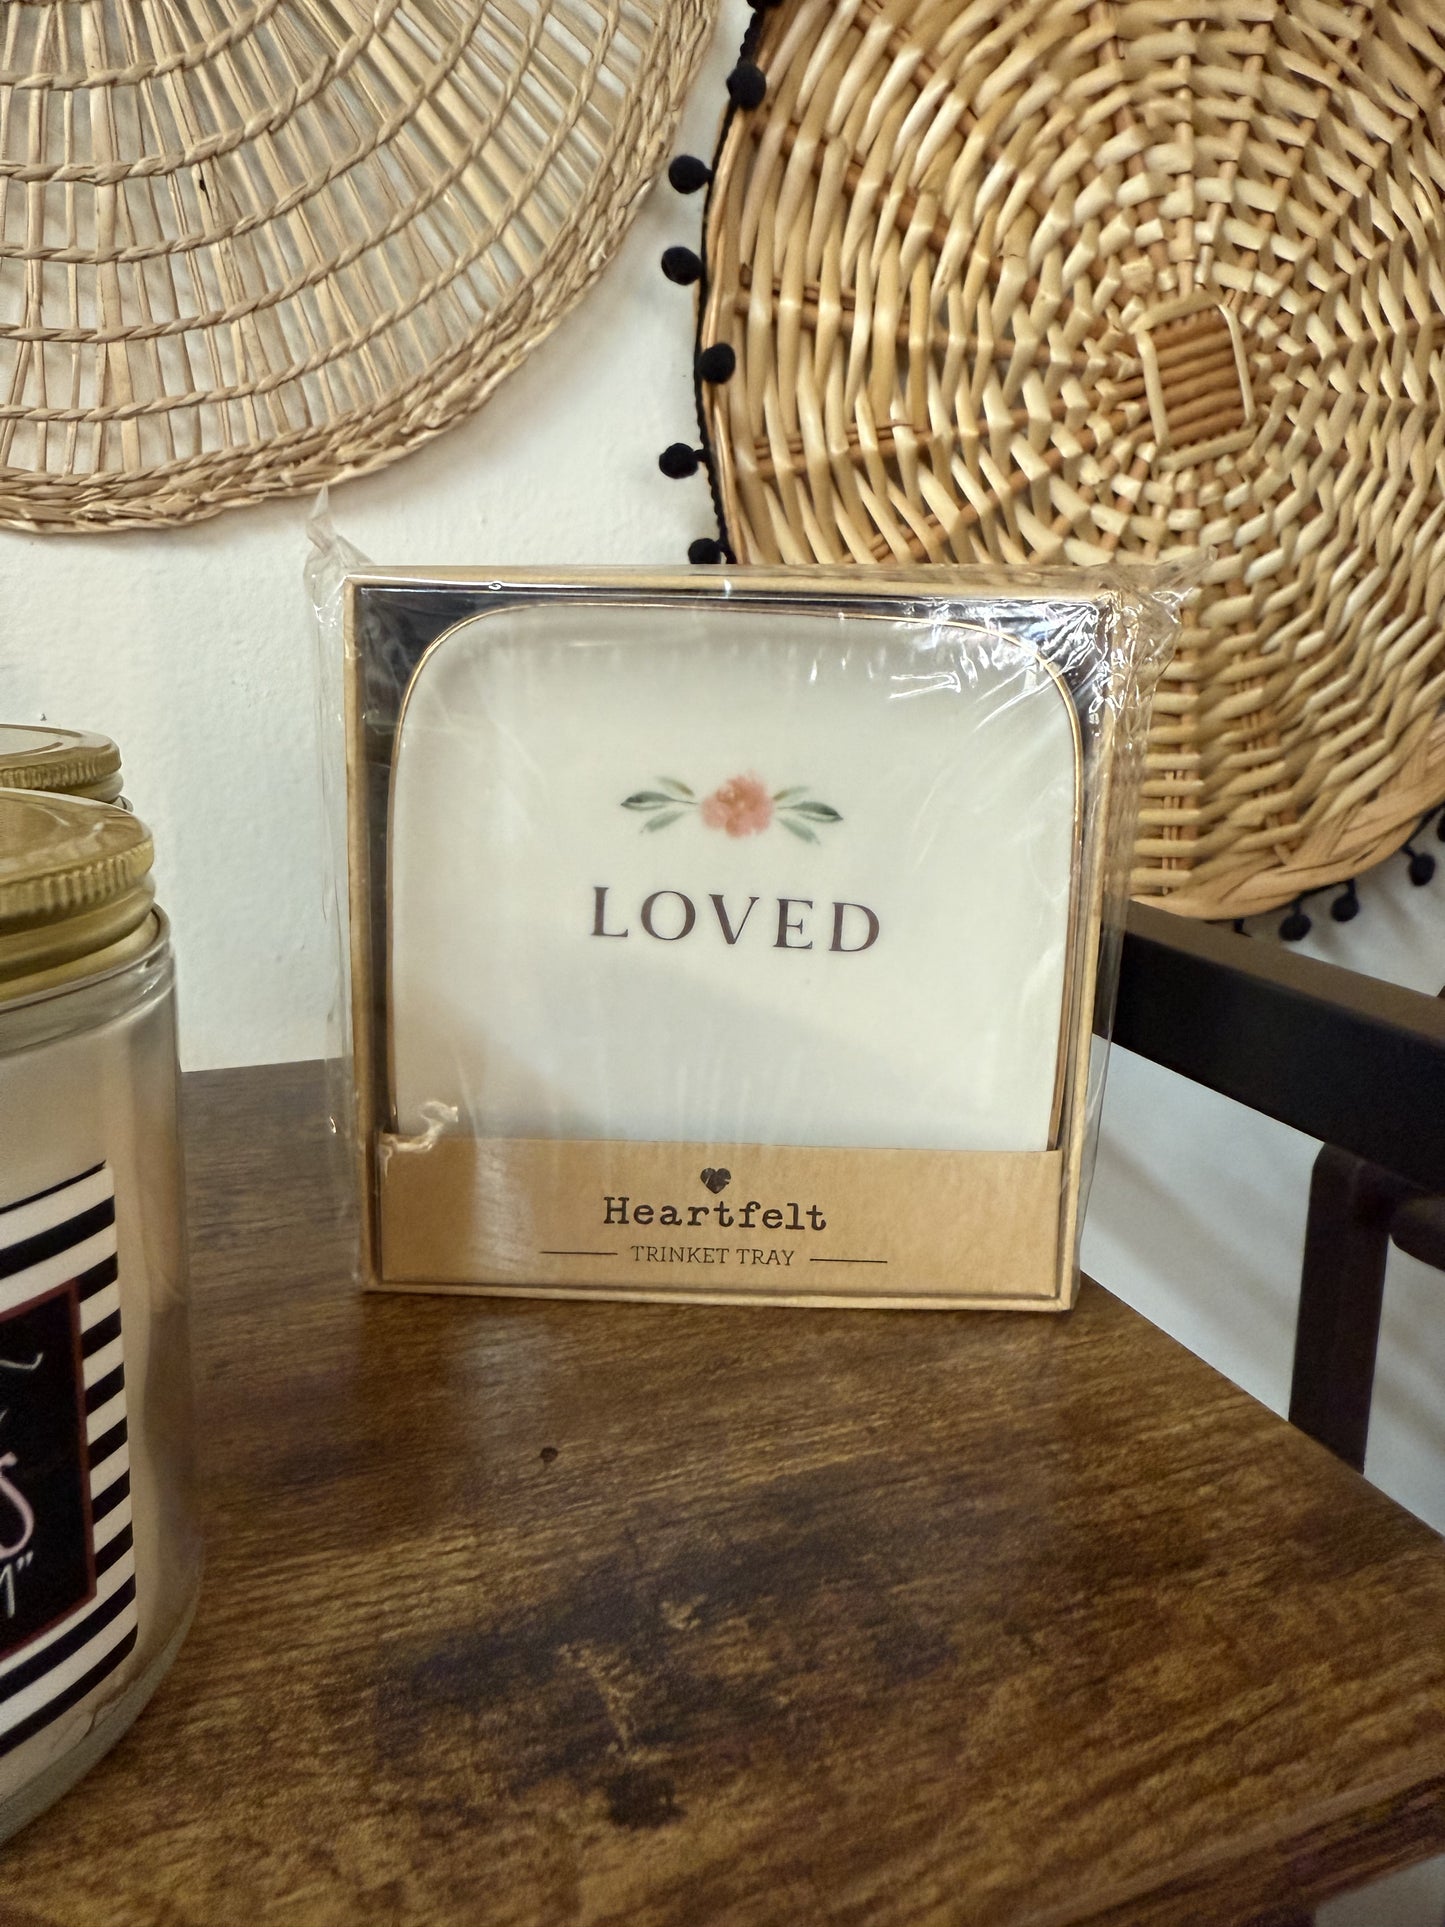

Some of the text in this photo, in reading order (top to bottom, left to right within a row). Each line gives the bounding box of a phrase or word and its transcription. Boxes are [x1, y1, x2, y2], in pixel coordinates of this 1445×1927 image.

[591, 886, 880, 952] LOVED
[603, 1197, 827, 1231] Heartfelt
[630, 1246, 795, 1266] TRINKET TRAY
